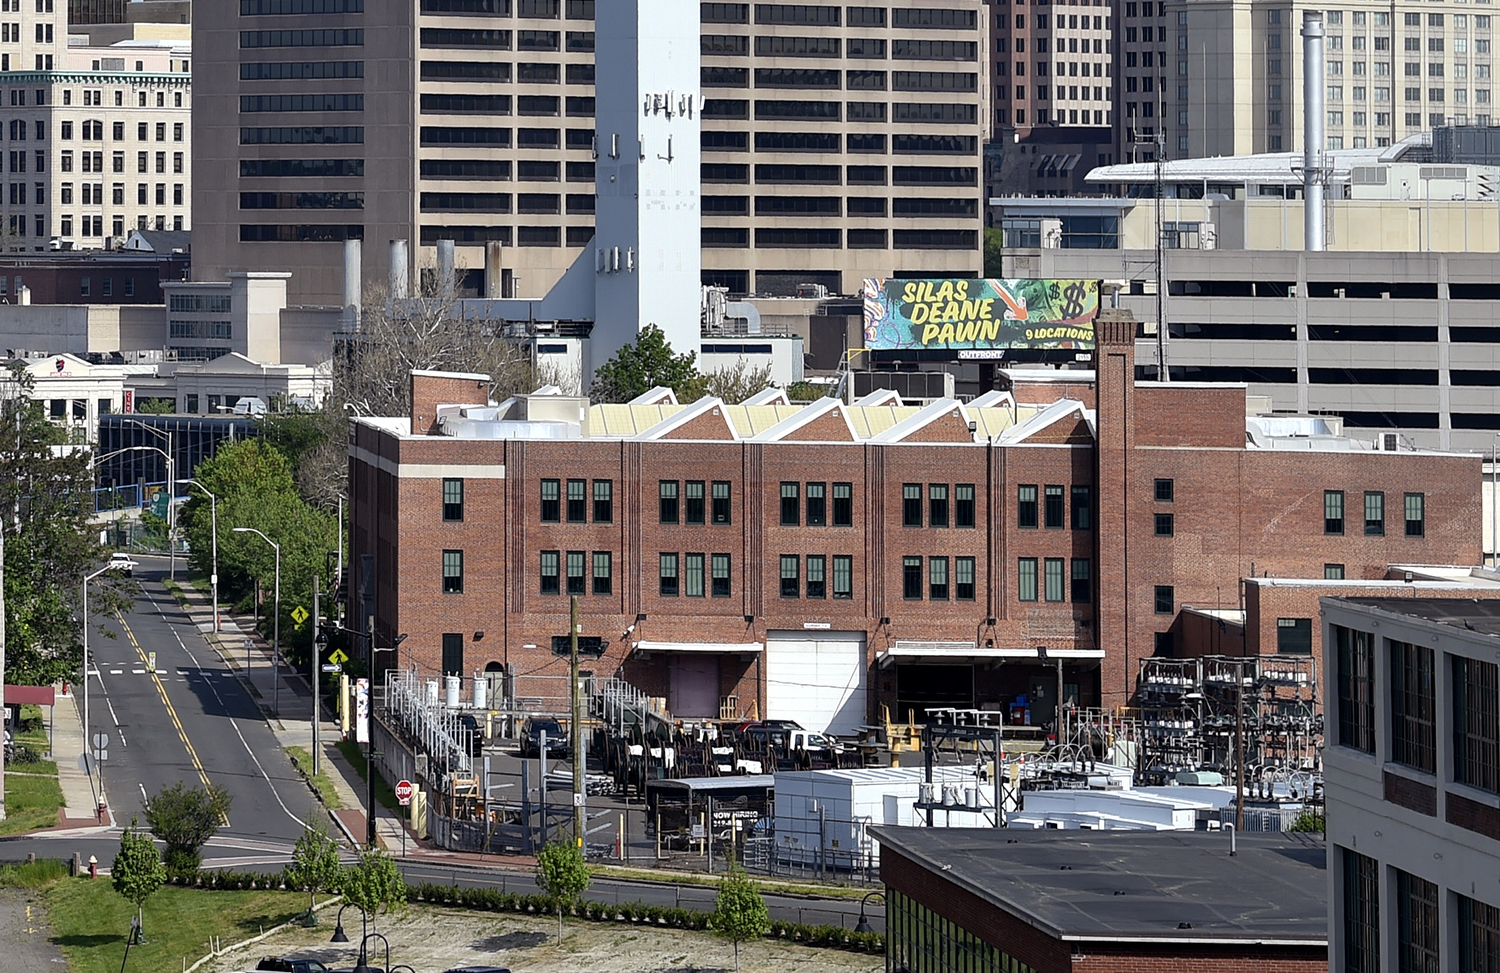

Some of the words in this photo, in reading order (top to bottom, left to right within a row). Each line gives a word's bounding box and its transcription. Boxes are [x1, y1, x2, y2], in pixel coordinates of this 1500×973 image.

[902, 280, 969, 304] SILAS
[910, 299, 995, 324] DEANE
[922, 319, 1000, 345] PAWN
[1025, 330, 1034, 340] 9
[1034, 328, 1094, 341] LOCATIONS
[397, 787, 412, 795] STOP
[713, 811, 731, 819] NOW
